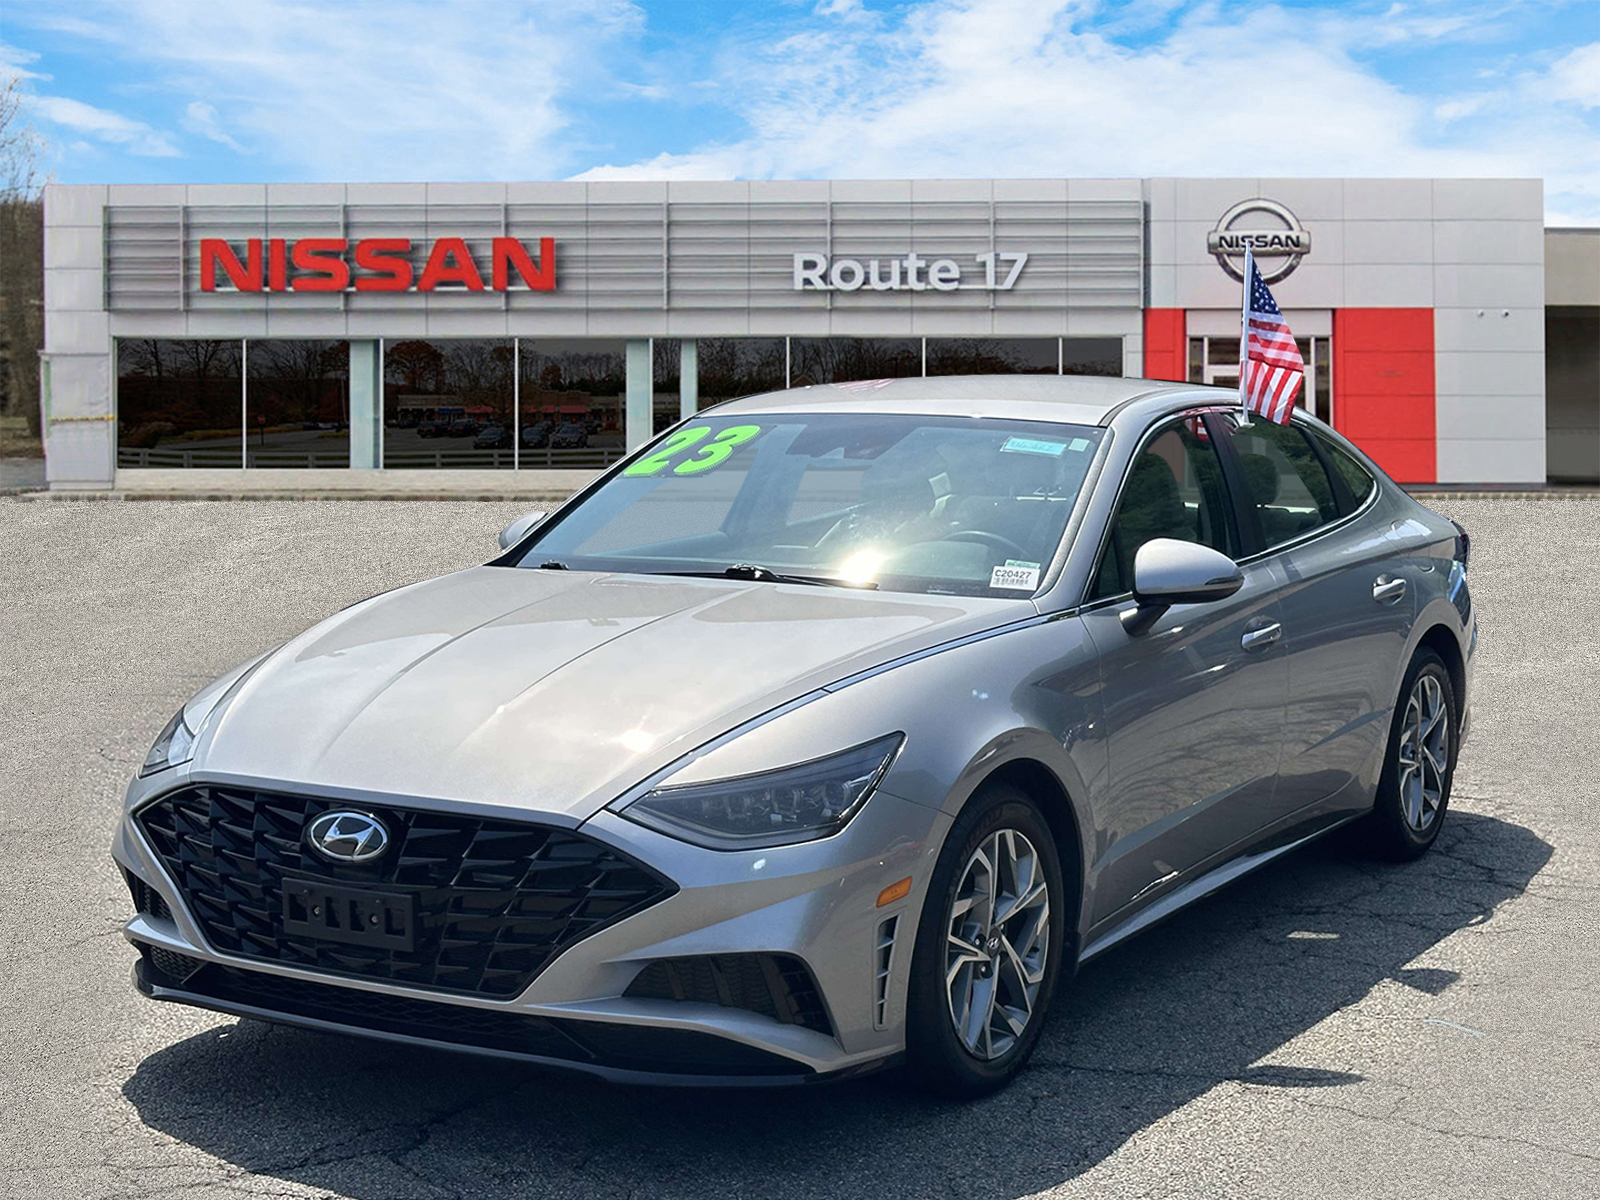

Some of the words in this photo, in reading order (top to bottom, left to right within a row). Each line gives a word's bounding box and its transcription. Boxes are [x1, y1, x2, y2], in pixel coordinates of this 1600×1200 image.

[1218, 235, 1300, 248] NISSAN
[200, 237, 556, 291] NISSAN
[793, 252, 960, 291] Route
[975, 251, 1029, 290] 17
[622, 425, 761, 477] 23
[994, 569, 1032, 579] C20427
